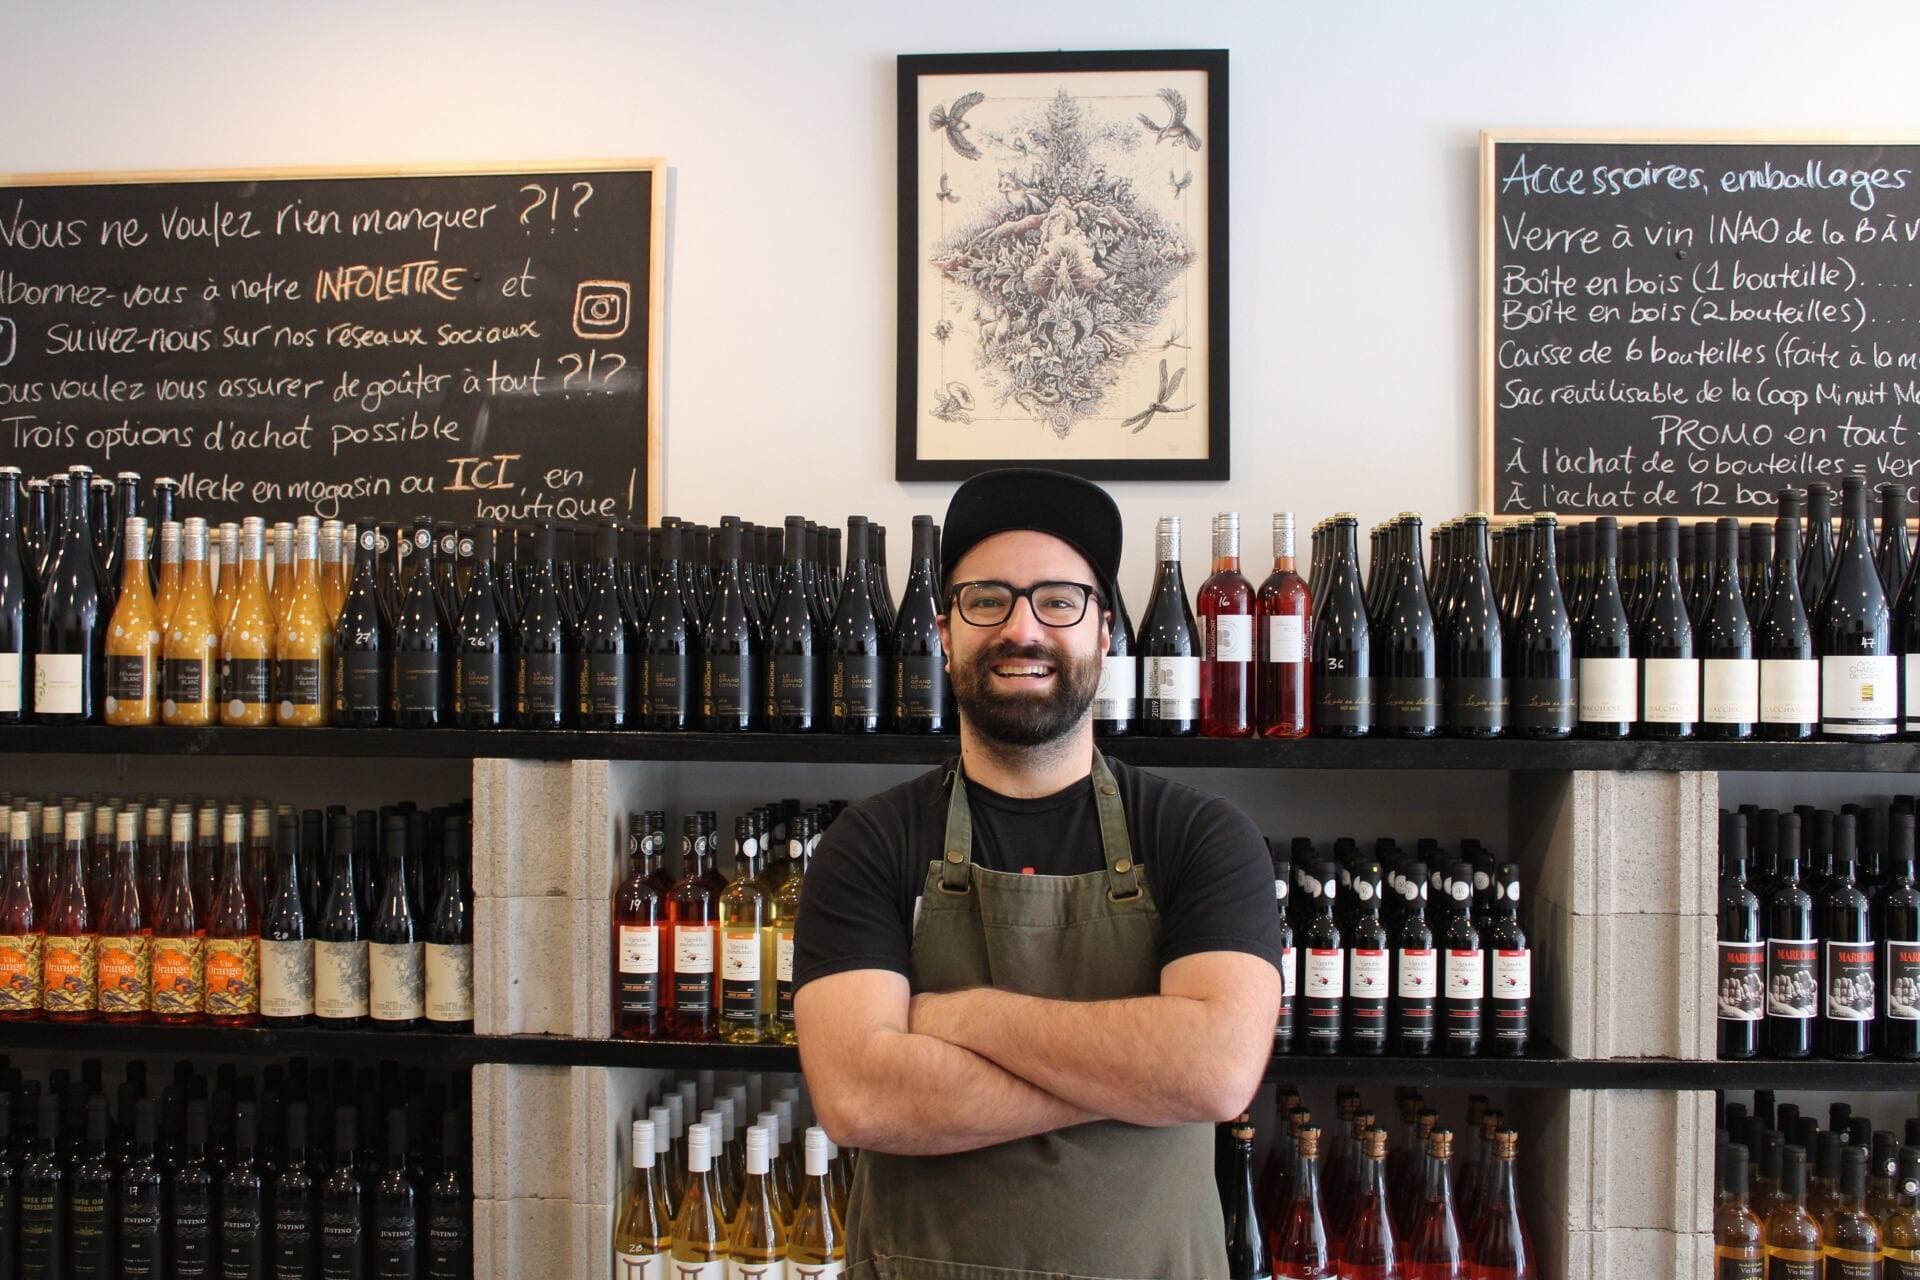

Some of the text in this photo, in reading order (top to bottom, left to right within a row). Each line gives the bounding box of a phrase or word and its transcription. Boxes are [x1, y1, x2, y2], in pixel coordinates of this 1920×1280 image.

[1502, 153, 1912, 211] Accessoires, emballages
[0, 199, 87, 249] Vous
[100, 217, 148, 249] ne
[162, 202, 260, 247] voulez
[277, 199, 342, 234] rien
[352, 204, 497, 251] manquer
[1502, 211, 1601, 254] Verre
[1612, 224, 1634, 249] à
[1645, 221, 1693, 247] vin
[1709, 210, 1779, 245] INAO
[1785, 218, 1814, 244] de
[1822, 219, 1845, 244] la
[203, 278, 220, 301] à
[232, 273, 302, 304] notre
[315, 259, 468, 303] INFOLETTRE
[502, 257, 537, 298] et
[1503, 265, 1577, 298] Boîte
[1585, 276, 1618, 296] en
[1626, 267, 1683, 295] bois
[1502, 300, 1578, 330] Boîte
[1589, 305, 1620, 323] en
[1630, 301, 1686, 323] bois
[46, 321, 212, 354] Suivez-nous
[223, 325, 271, 347] sur
[274, 325, 317, 348] nos
[1498, 340, 1572, 369] Caisse
[1579, 341, 1612, 364] de
[1626, 338, 1643, 362] 6
[1651, 336, 1766, 366] bouteilles
[1850, 344, 1866, 366] à
[1874, 341, 1892, 368] la
[50, 374, 145, 401] voulez
[156, 379, 207, 400] vous
[218, 376, 324, 399] assurer
[333, 371, 360, 402] de
[463, 368, 480, 394] à
[486, 358, 546, 397] tout
[1499, 379, 1544, 409] Sac
[1696, 380, 1723, 404] de
[1732, 377, 1751, 402] la
[1757, 377, 1808, 415] Coop
[1816, 381, 1888, 405] Minuit
[1, 411, 460, 460] Trois options d'achat possible
[1651, 414, 1908, 450] PROMO en tout
[1542, 446, 1636, 474] l'achat
[1641, 451, 1676, 473] de
[1688, 452, 1709, 474] 6
[1716, 451, 1845, 475] bouteilles
[253, 480, 282, 503] en
[288, 468, 391, 518] magasin
[401, 474, 434, 494] ou
[544, 467, 583, 489] en
[1543, 480, 1637, 507] l'achat
[1643, 480, 1679, 506] de
[1690, 481, 1727, 506] 12
